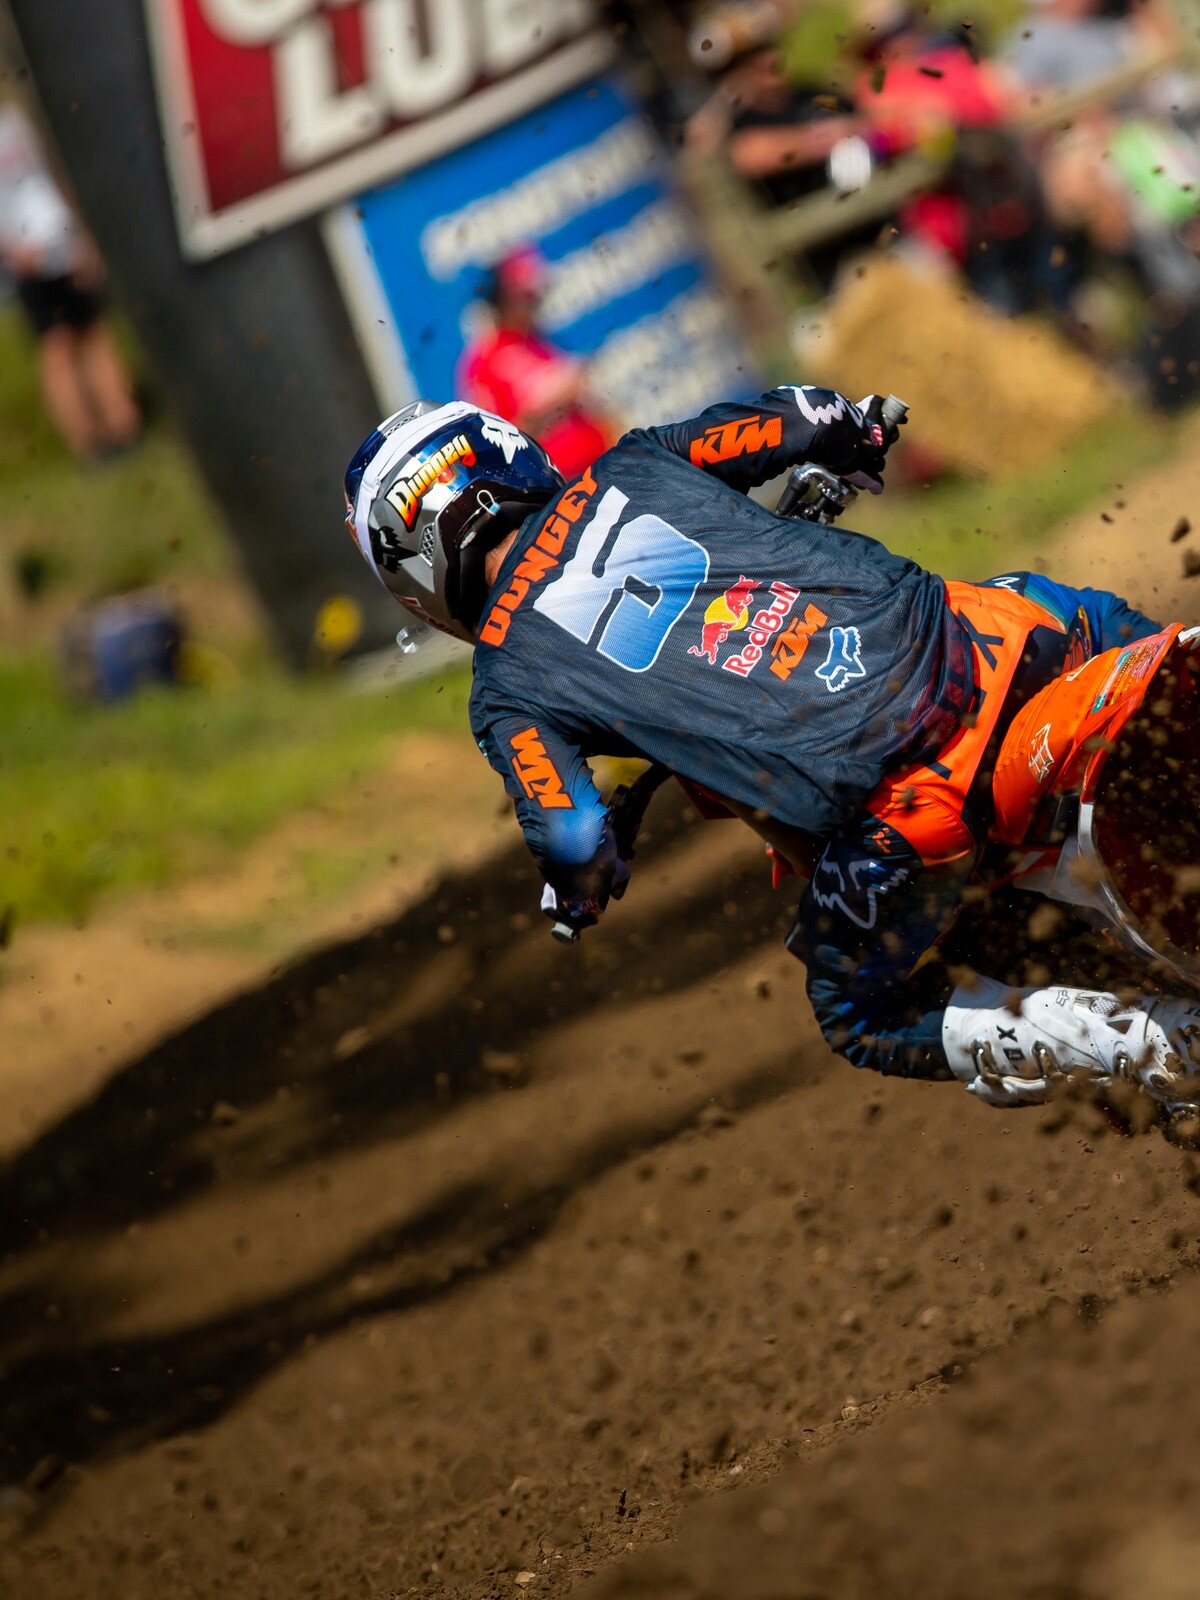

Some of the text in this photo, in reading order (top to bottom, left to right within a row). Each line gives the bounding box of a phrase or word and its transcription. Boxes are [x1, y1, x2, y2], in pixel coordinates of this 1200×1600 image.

[385, 433, 479, 533] Dungey
[689, 415, 783, 468] KTM
[479, 465, 598, 647] DUNGEY
[532, 485, 710, 673] 5
[769, 602, 829, 682] KTM
[510, 727, 574, 809] KTM
